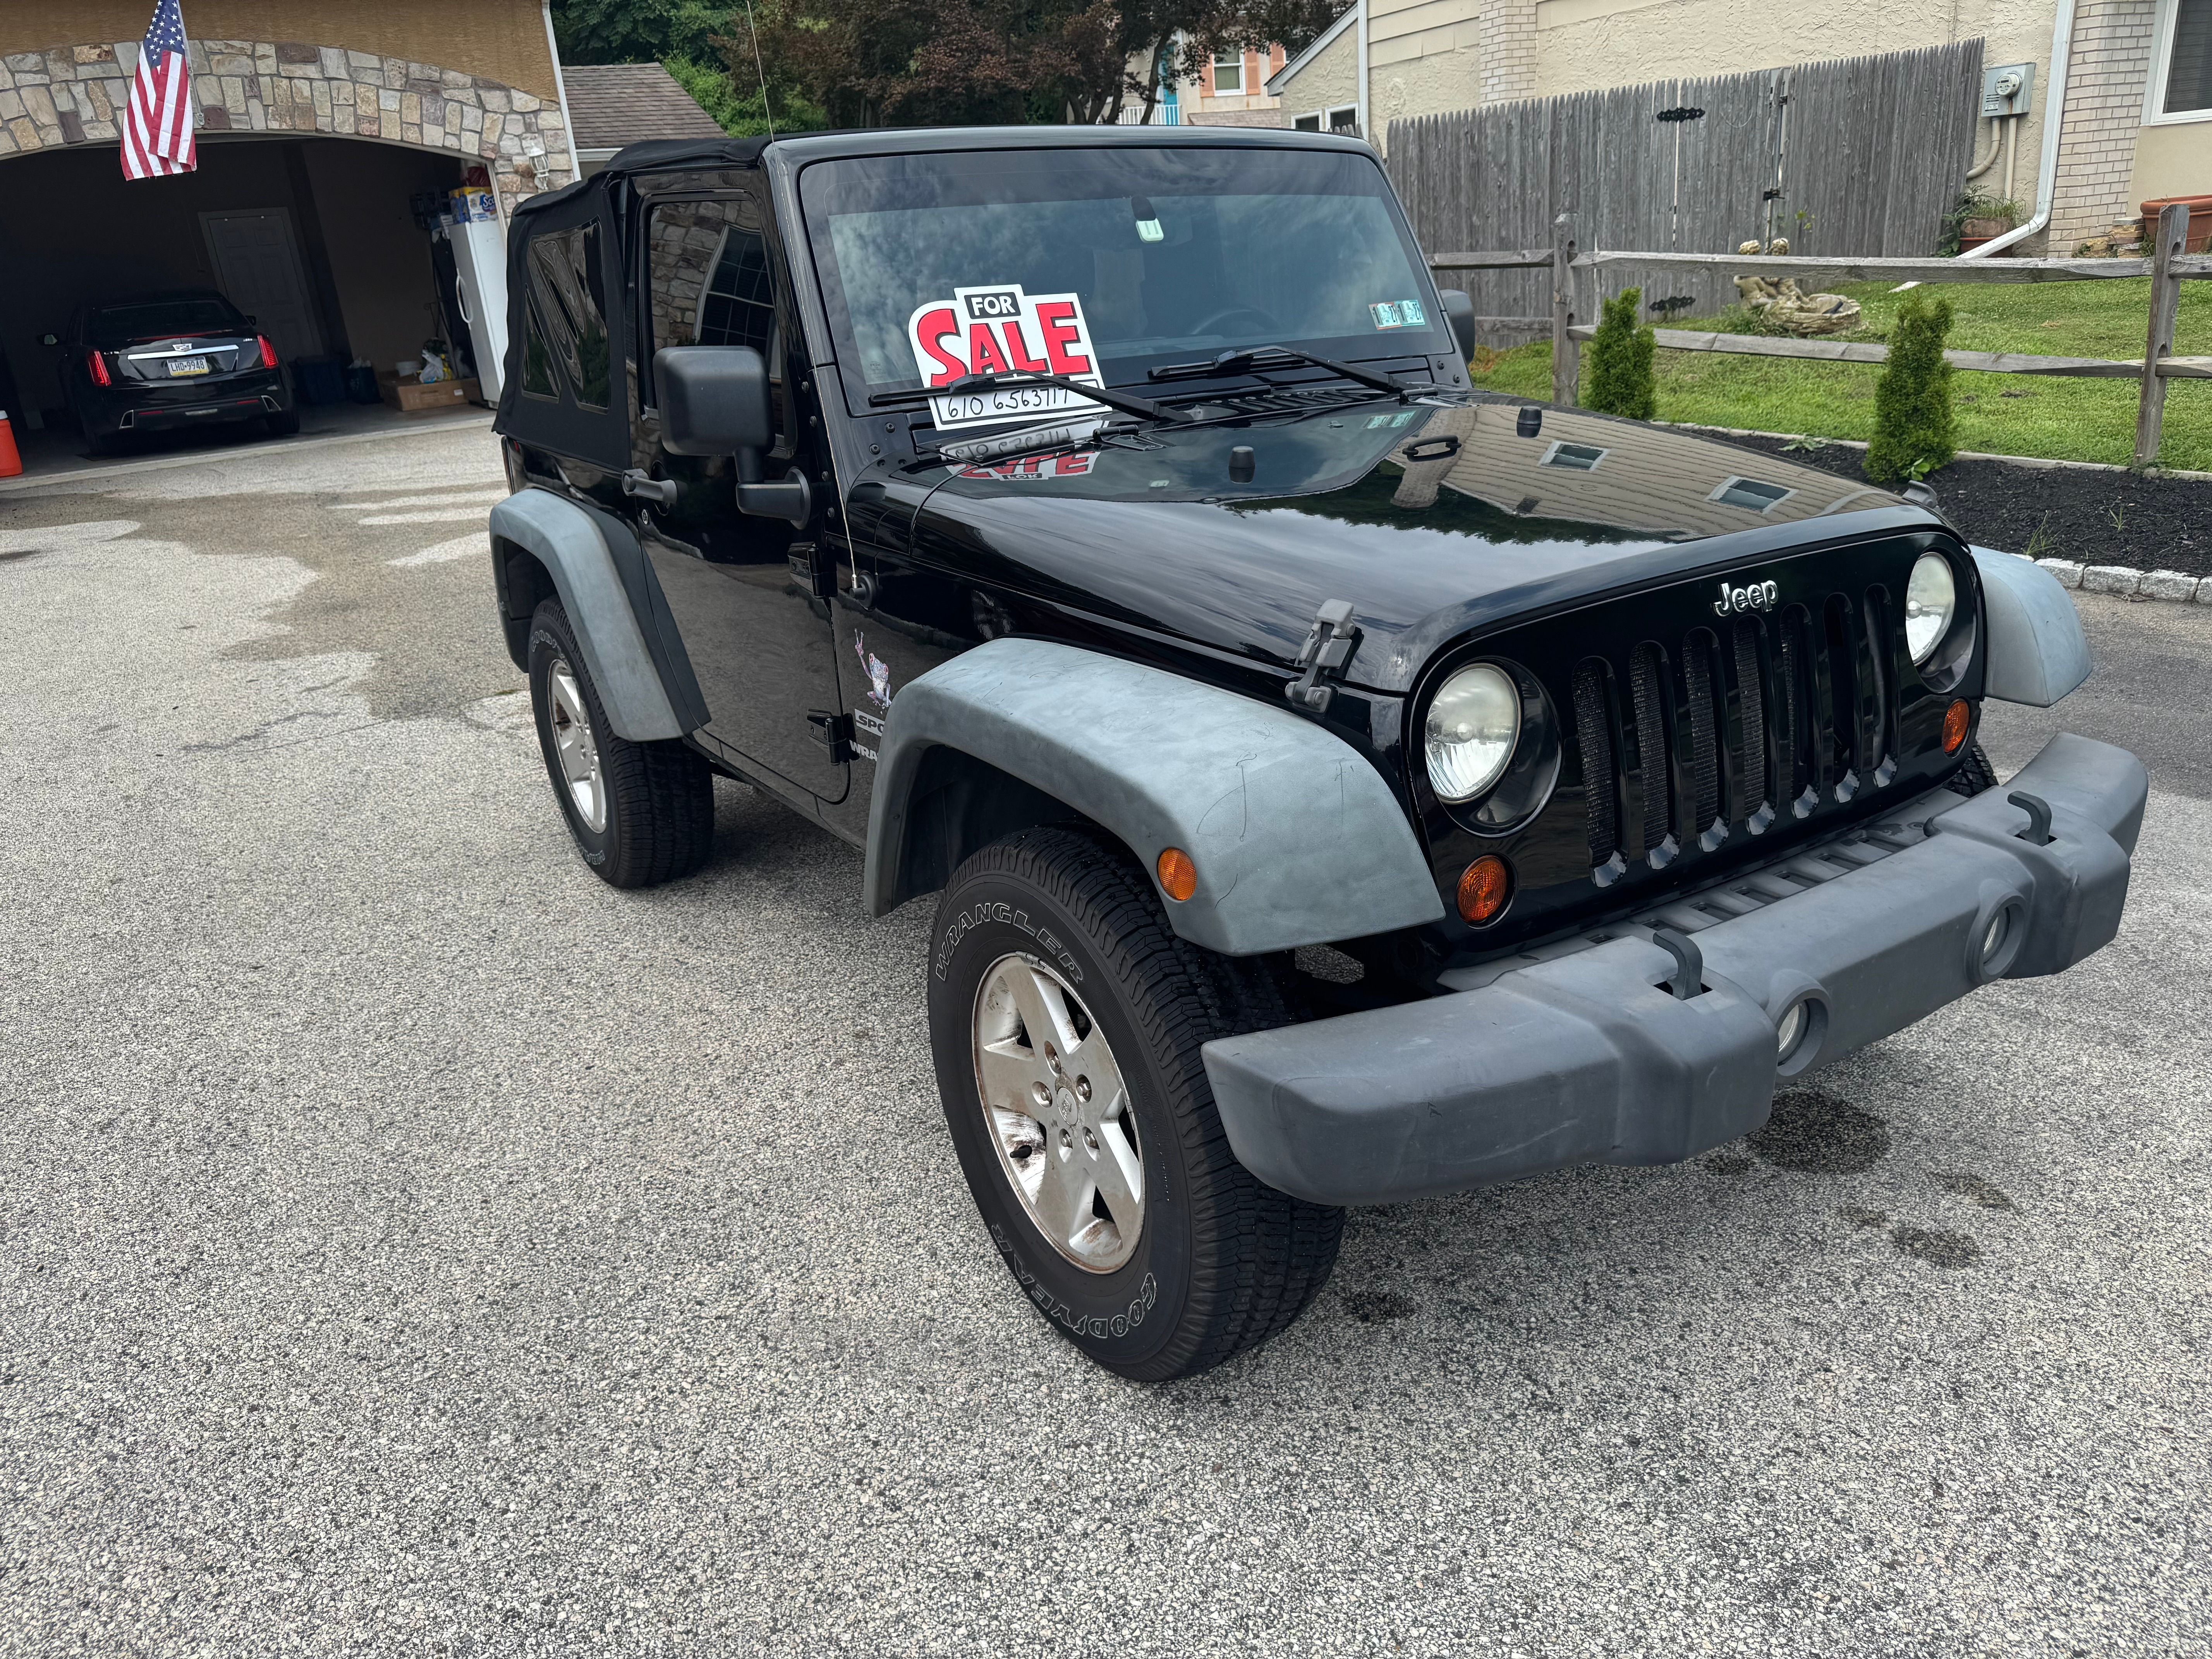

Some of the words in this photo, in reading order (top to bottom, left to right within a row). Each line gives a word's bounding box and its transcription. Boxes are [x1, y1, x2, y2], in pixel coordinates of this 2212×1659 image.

[971, 296, 1016, 316] FOR
[917, 302, 1093, 386] SALE
[948, 397, 984, 418] 610
[993, 388, 1068, 410] 6563717
[1712, 580, 1779, 617] Jeep
[935, 902, 1084, 984] WRANGLER
[991, 1224, 1158, 1338] GOODYEAR
